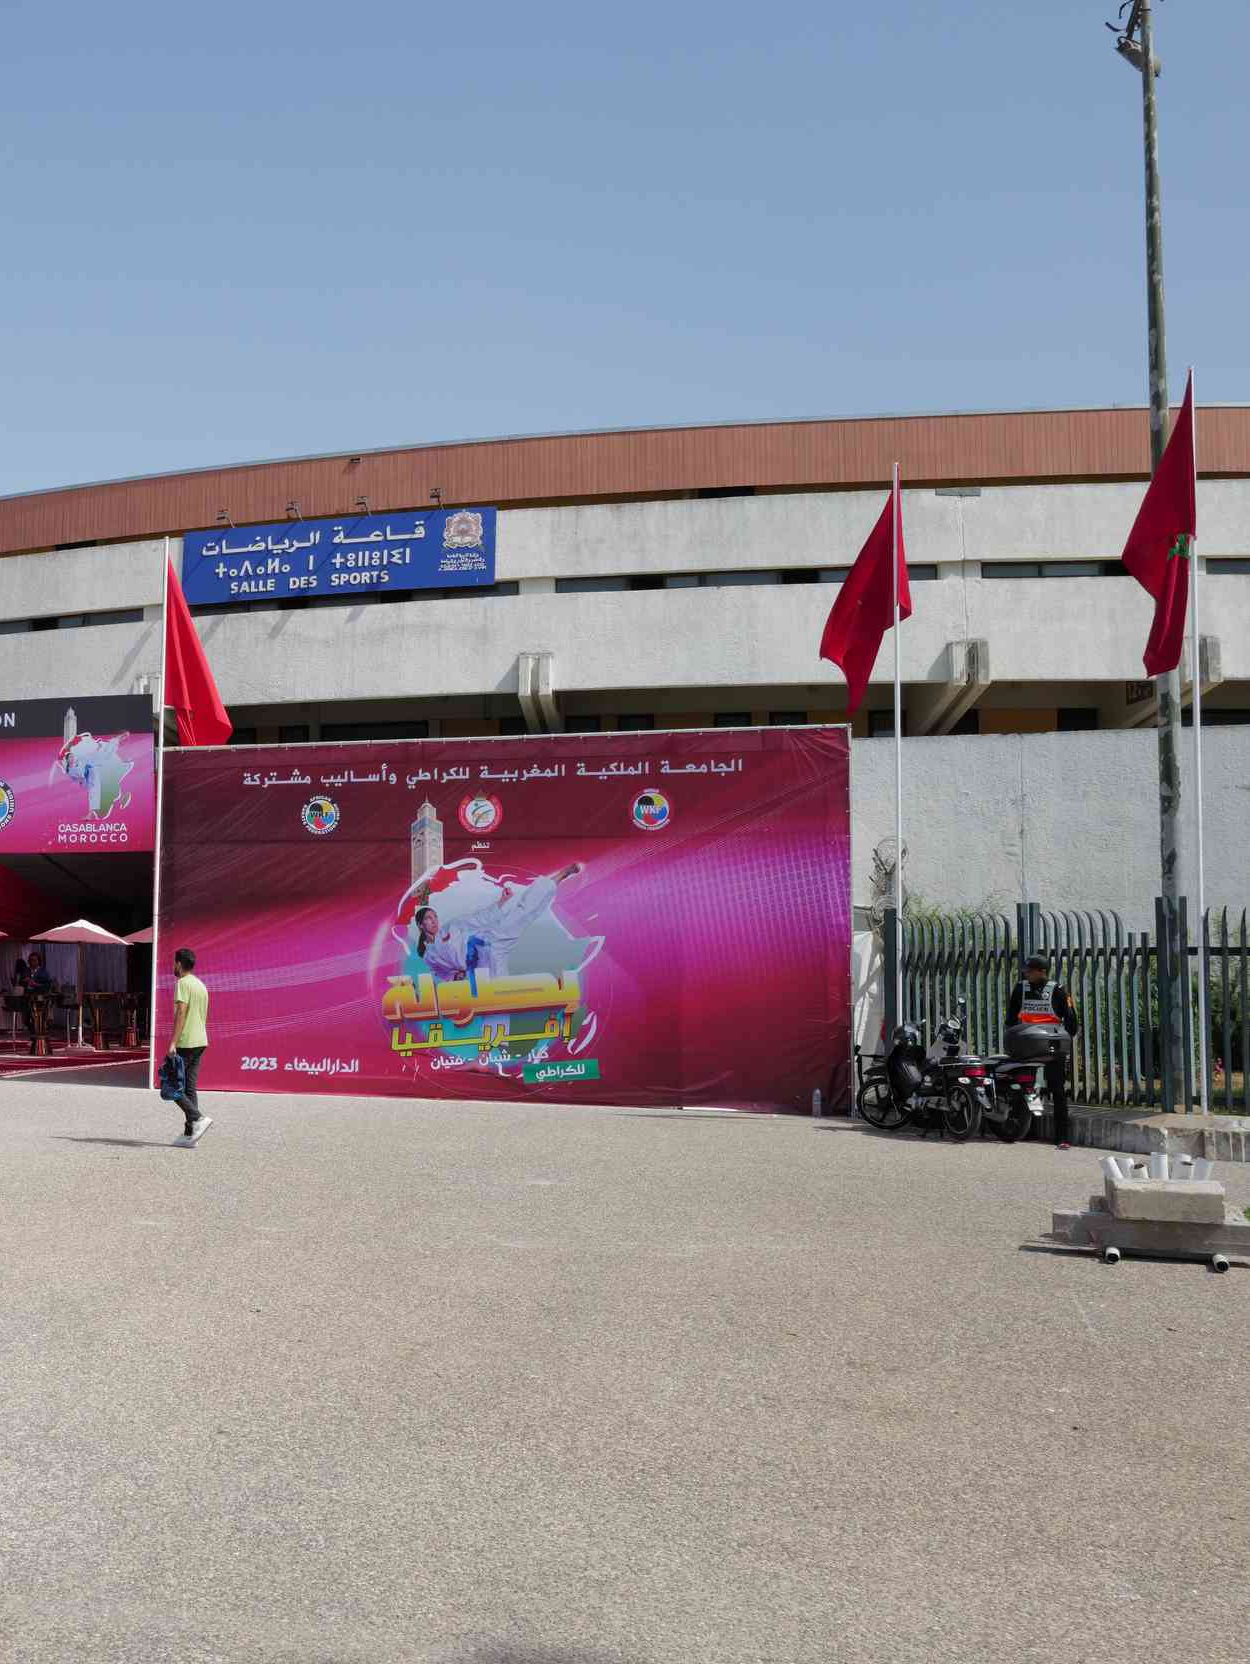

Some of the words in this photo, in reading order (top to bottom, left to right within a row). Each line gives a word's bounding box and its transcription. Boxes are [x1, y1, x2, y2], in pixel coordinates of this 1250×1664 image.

[333, 520, 426, 543] قاعة
[202, 530, 320, 556] الرياضات
[231, 579, 276, 594] SALLE
[289, 576, 318, 590] DES
[331, 571, 390, 586] SPORTS
[320, 763, 398, 788] وأساليب
[479, 763, 566, 783] المغربية
[576, 761, 650, 780] الملكية
[661, 758, 743, 777] الجامعة
[243, 768, 312, 788] مشتركة
[406, 767, 470, 789] للكراطي
[58, 823, 127, 833] CASABLANCA
[58, 834, 128, 843] MOROCCO
[382, 968, 580, 1026] بطولة
[240, 1056, 278, 1071] 2023
[535, 1063, 586, 1081] للكراطي
